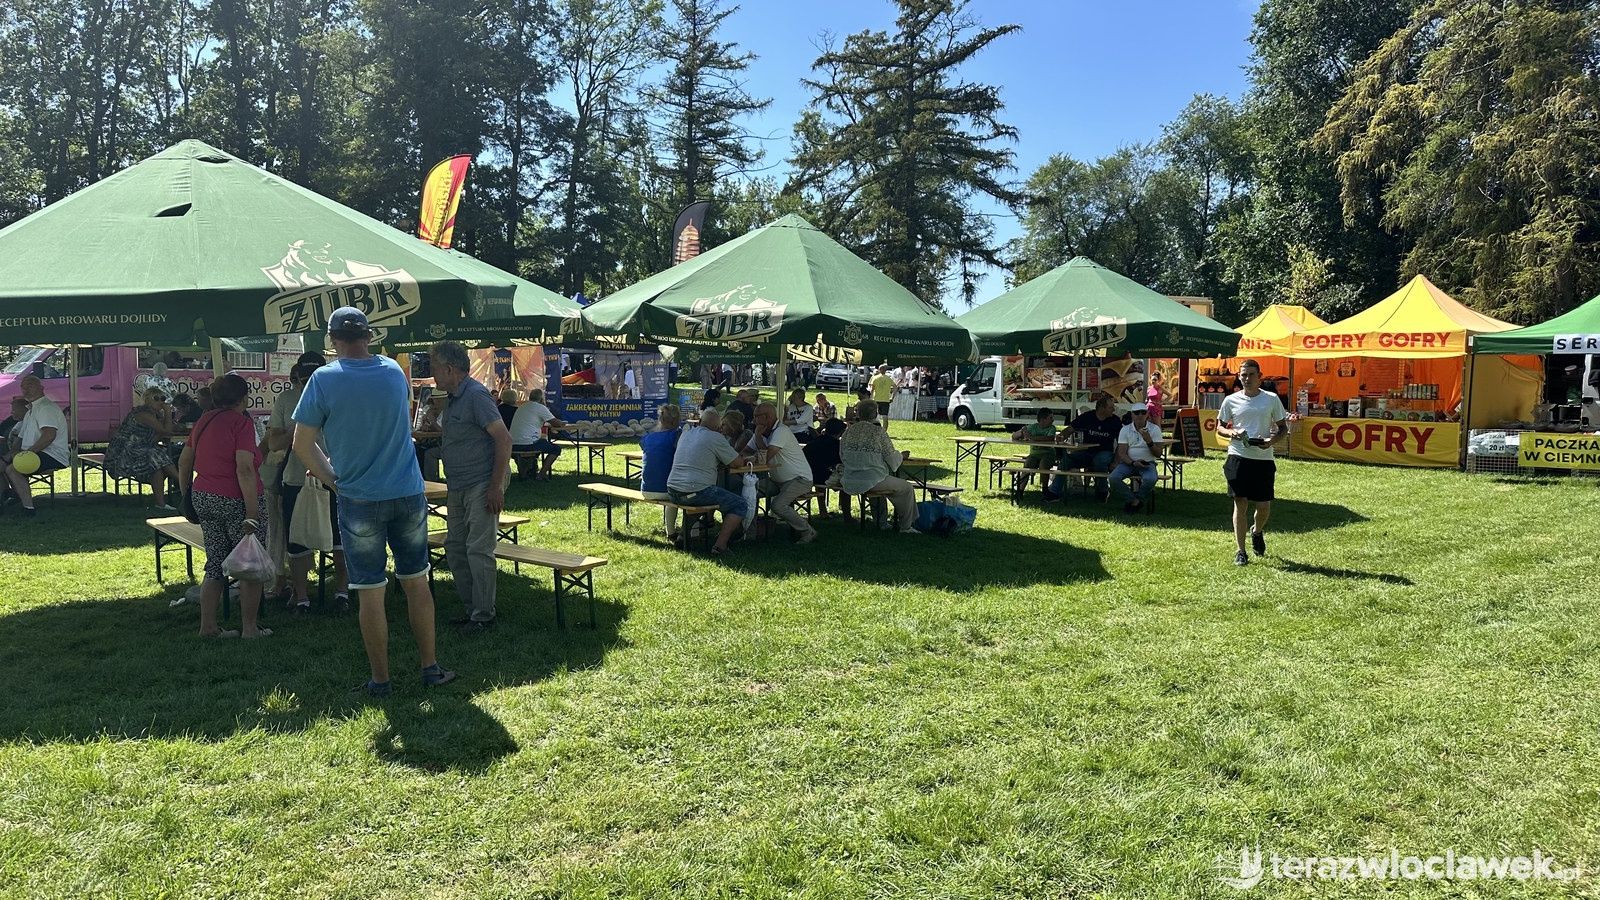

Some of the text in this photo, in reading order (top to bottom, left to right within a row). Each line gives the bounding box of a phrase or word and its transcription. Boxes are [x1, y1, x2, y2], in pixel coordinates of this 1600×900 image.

[279, 278, 409, 334] ZUBR
[59, 314, 117, 325] BROWARU
[120, 313, 167, 324] DOJLIDY
[684, 310, 772, 339] ZUBR
[1050, 324, 1119, 351] ZUBR
[1237, 338, 1273, 350] NITA
[1302, 332, 1451, 349] GOFRY GOFRY
[1311, 422, 1435, 454] GOFRY
[1523, 451, 1541, 461] W
